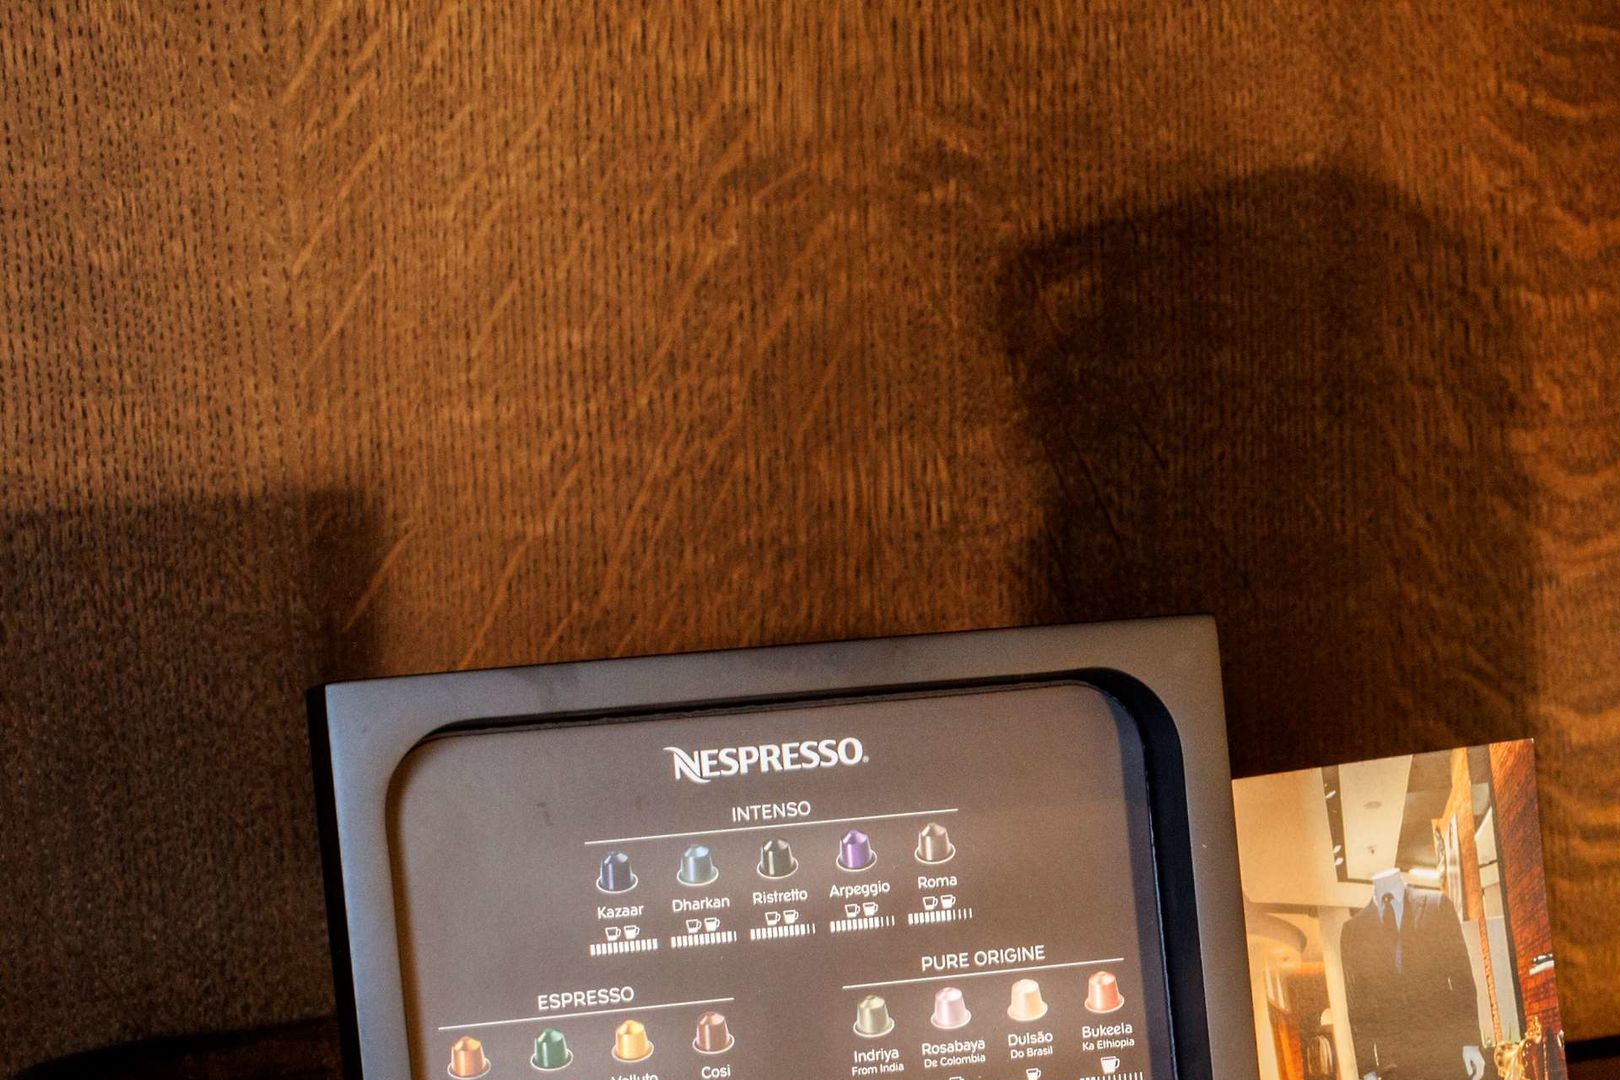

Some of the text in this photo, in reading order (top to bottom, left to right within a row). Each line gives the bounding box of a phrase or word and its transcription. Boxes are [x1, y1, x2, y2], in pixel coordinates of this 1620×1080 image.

[664, 737, 866, 784] NESPRESSO
[732, 801, 811, 823] INTENSO
[829, 880, 891, 898] Arpeggio
[917, 874, 958, 889] Roma
[672, 895, 730, 912] Dharkan
[752, 888, 808, 905] Ristretto
[597, 903, 644, 920] Kazaar
[921, 944, 1046, 972] PURE ORIGINE
[537, 986, 635, 1011] ESPRESSO
[1007, 1031, 1053, 1046] Dulsão
[1081, 1022, 1133, 1038] Bukeela
[921, 1038, 985, 1057] Rosabaya
[1010, 1045, 1053, 1059] Do Brasil
[1082, 1037, 1135, 1051] Ka Ethiopia
[853, 1047, 900, 1066] Indriya
[924, 1053, 986, 1069] De Colombia
[701, 1064, 731, 1079] Cosi
[851, 1061, 904, 1077] From India
